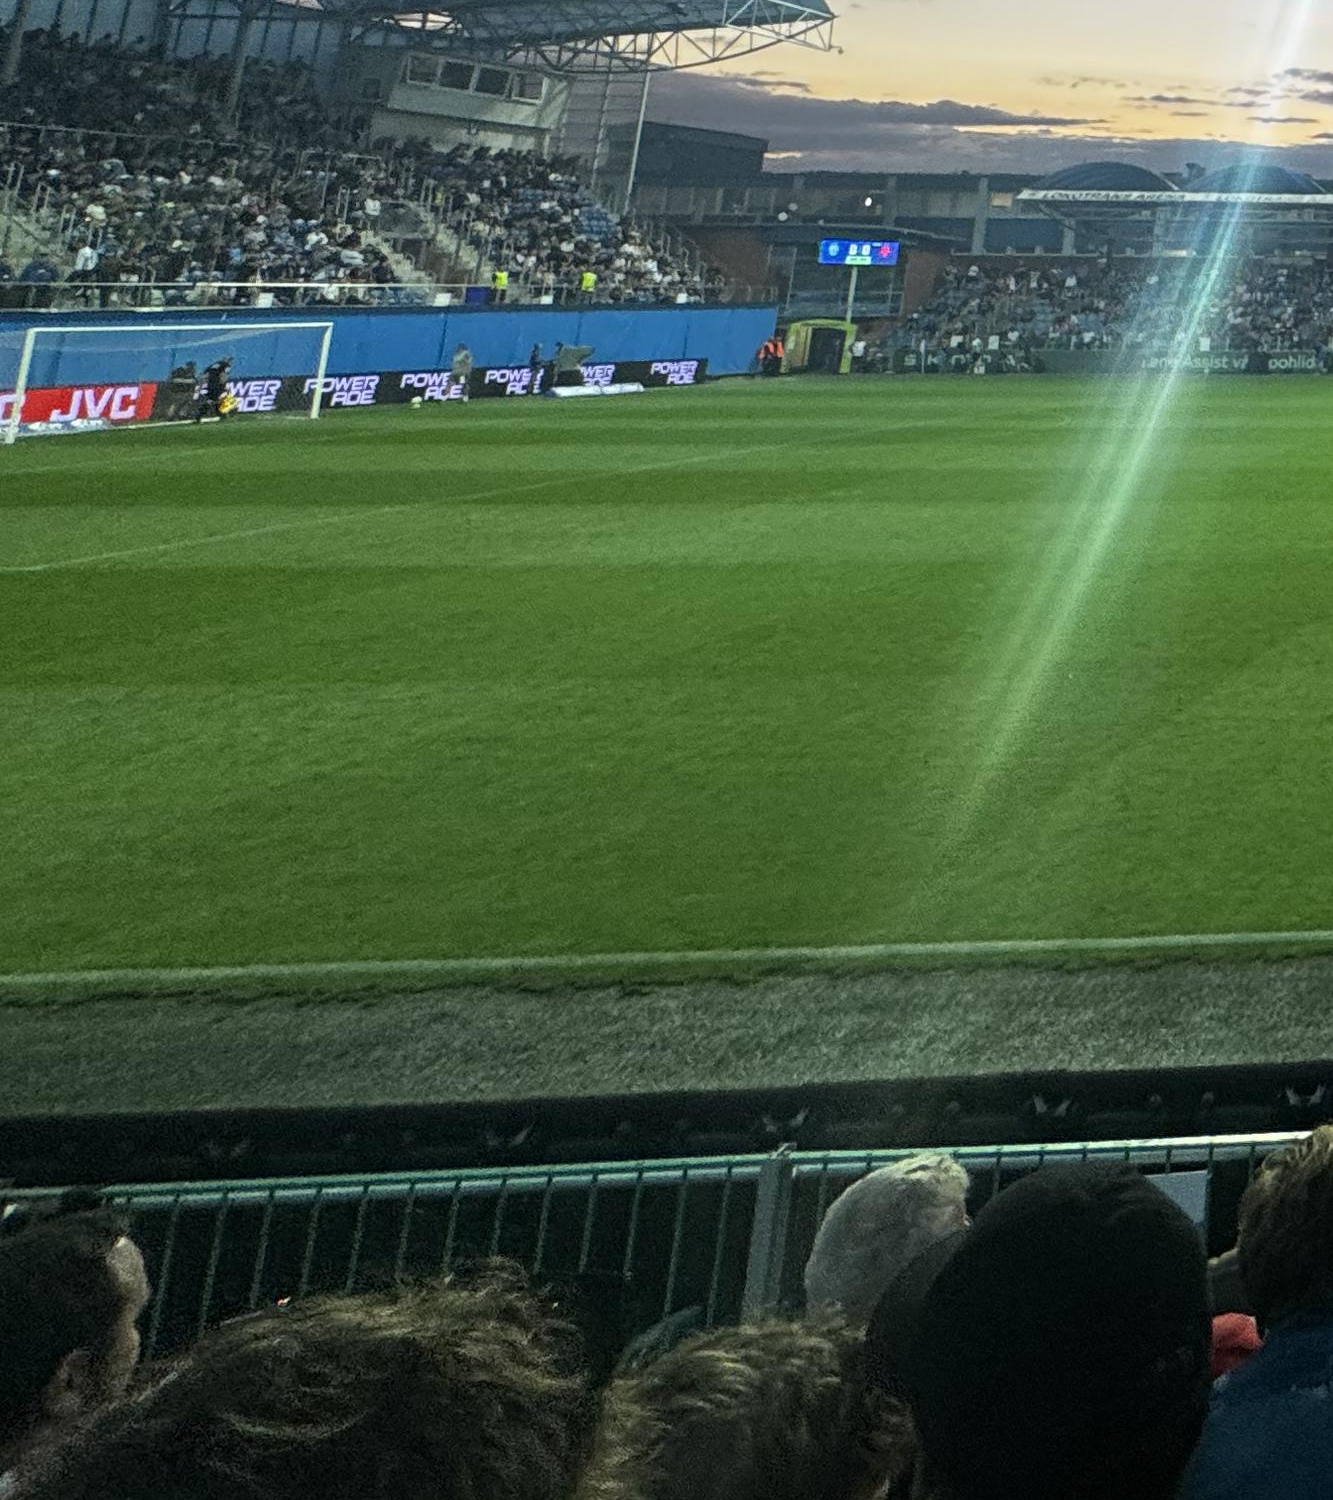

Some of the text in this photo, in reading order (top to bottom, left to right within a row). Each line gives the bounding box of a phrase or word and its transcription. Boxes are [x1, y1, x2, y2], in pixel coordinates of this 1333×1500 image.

[484, 368, 544, 384] POWE
[651, 361, 698, 375] POWER
[303, 375, 380, 394] POWER
[400, 372, 452, 389] POWE
[50, 387, 140, 422] JVC
